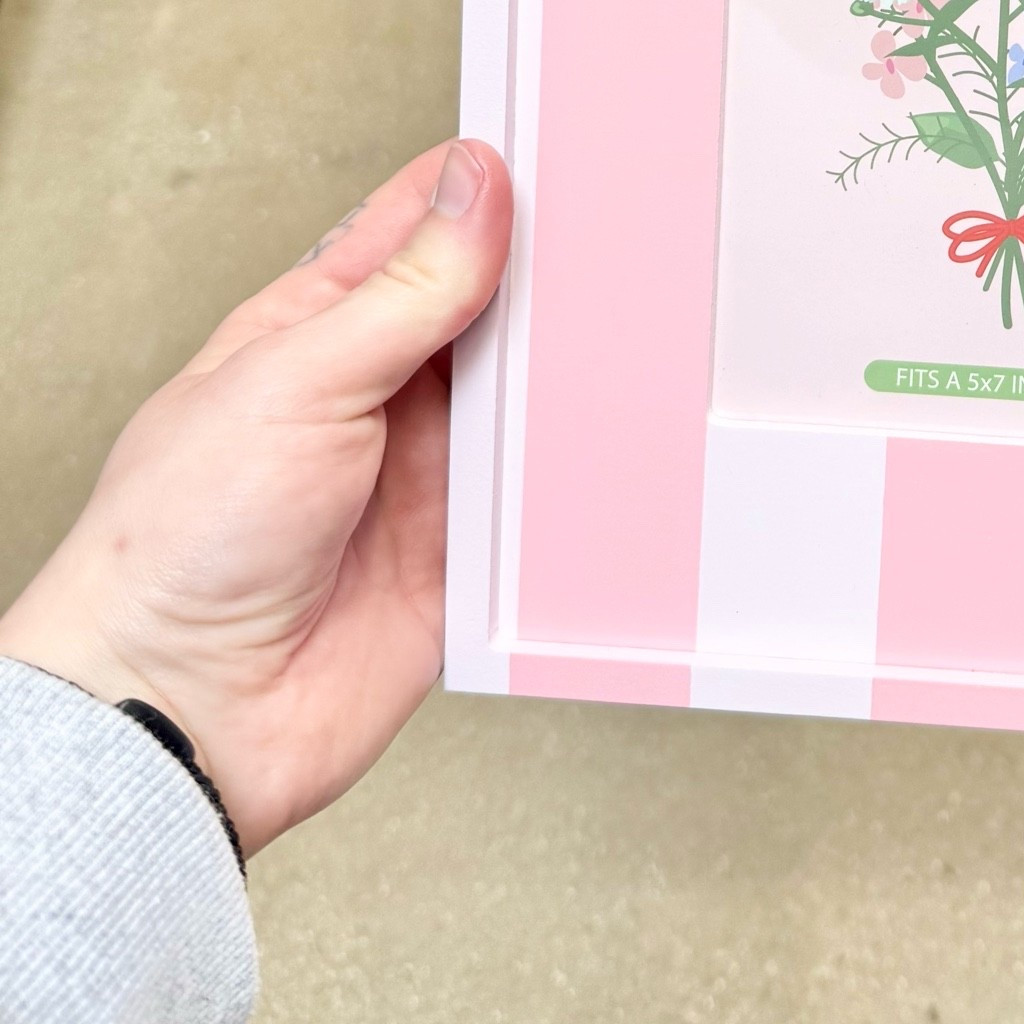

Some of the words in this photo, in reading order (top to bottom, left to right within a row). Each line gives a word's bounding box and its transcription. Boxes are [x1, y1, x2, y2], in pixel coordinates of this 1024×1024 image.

[896, 368, 939, 389] FITS
[945, 371, 961, 390] A
[967, 373, 1006, 393] 5x7
